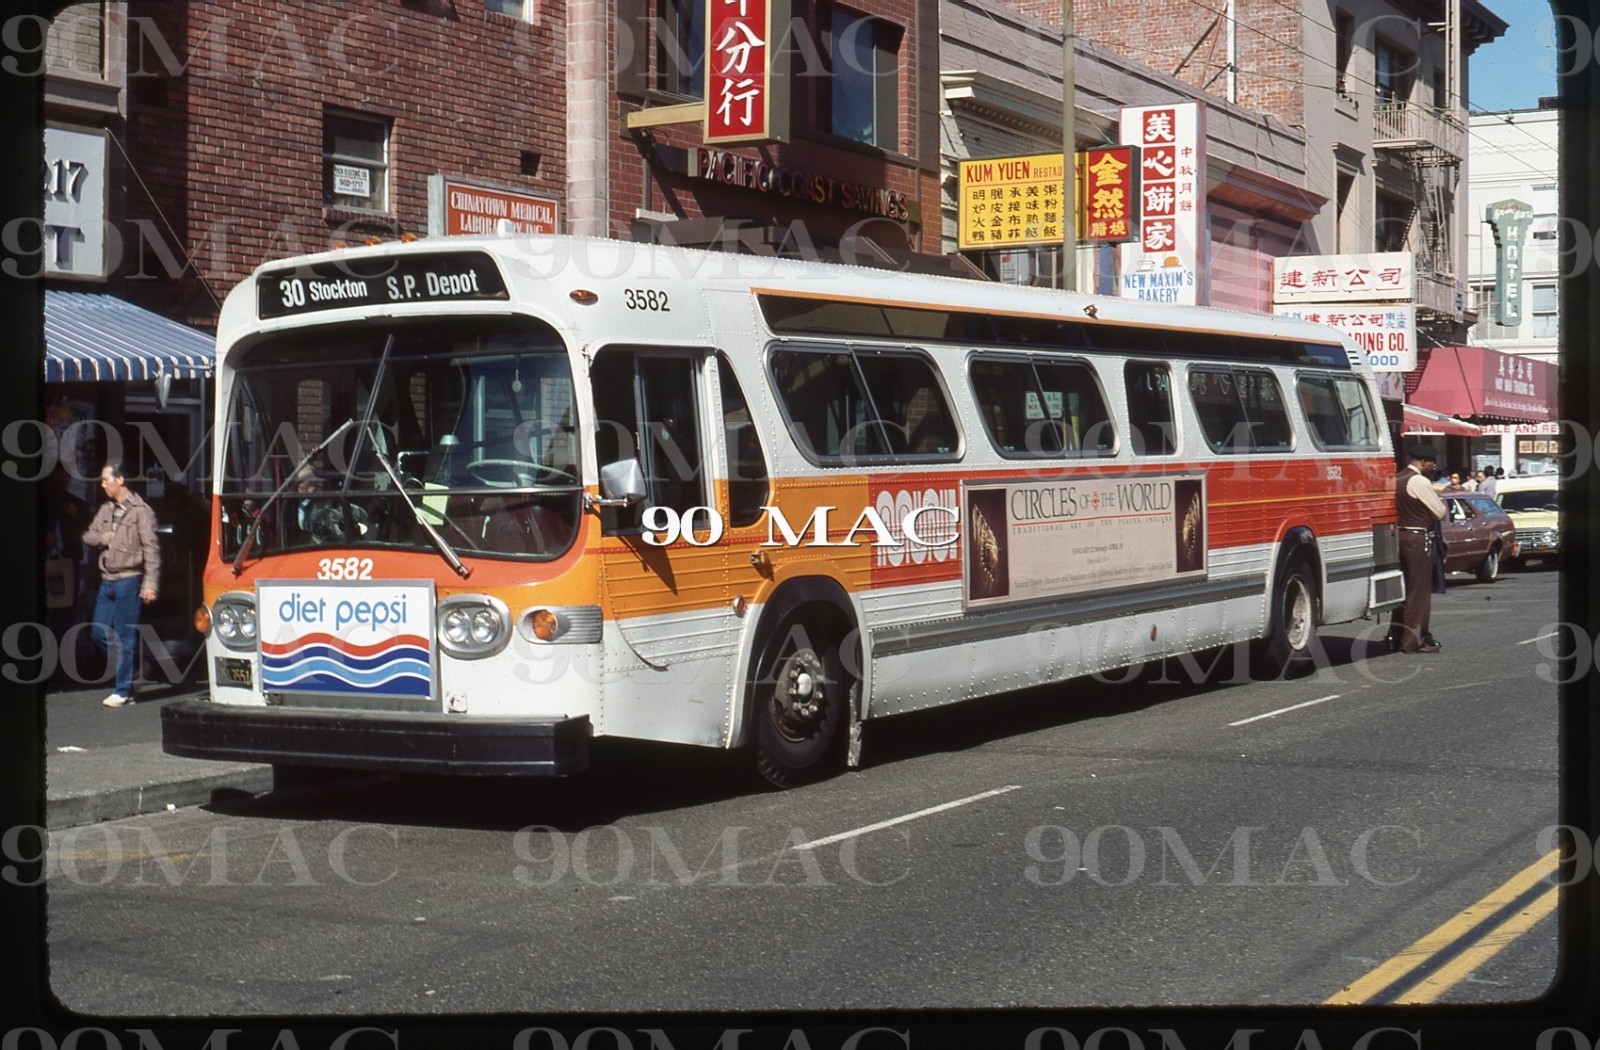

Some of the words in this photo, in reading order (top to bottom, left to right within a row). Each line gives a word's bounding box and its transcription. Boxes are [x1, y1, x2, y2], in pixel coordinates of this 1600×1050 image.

[44, 159, 86, 200] 17
[697, 149, 774, 192] PACIFIC
[841, 182, 909, 220] SAVINGS
[966, 165, 993, 183] KUM
[998, 161, 1030, 181] YUEN
[1033, 164, 1084, 179] RESTAUNT
[1090, 153, 1127, 218] 金然
[1145, 108, 1175, 251] 美心餅家
[451, 191, 507, 217] CHINATOWN
[510, 201, 553, 224] MEDICAL
[1124, 275, 1146, 288] NEW
[1150, 270, 1193, 287] MAXIM'S
[1280, 267, 1402, 289] 建新公司
[1506, 226, 1518, 317] HOTEL
[280, 279, 305, 307] 30
[309, 280, 368, 301] Stockton
[427, 269, 479, 296] Depot
[624, 288, 670, 311] 3582
[1138, 288, 1179, 302] BAKERY
[1348, 333, 1384, 351] DING
[1388, 332, 1409, 351] CO.
[1370, 355, 1399, 366] OOD
[1515, 424, 1538, 433] AND
[1011, 487, 1077, 521] CIRCLES
[1080, 494, 1090, 509] OF
[1101, 492, 1115, 508] THE
[1117, 483, 1172, 512] WORLD
[317, 557, 374, 580] 3582
[279, 593, 327, 623] diet
[335, 594, 407, 632] pepsi
